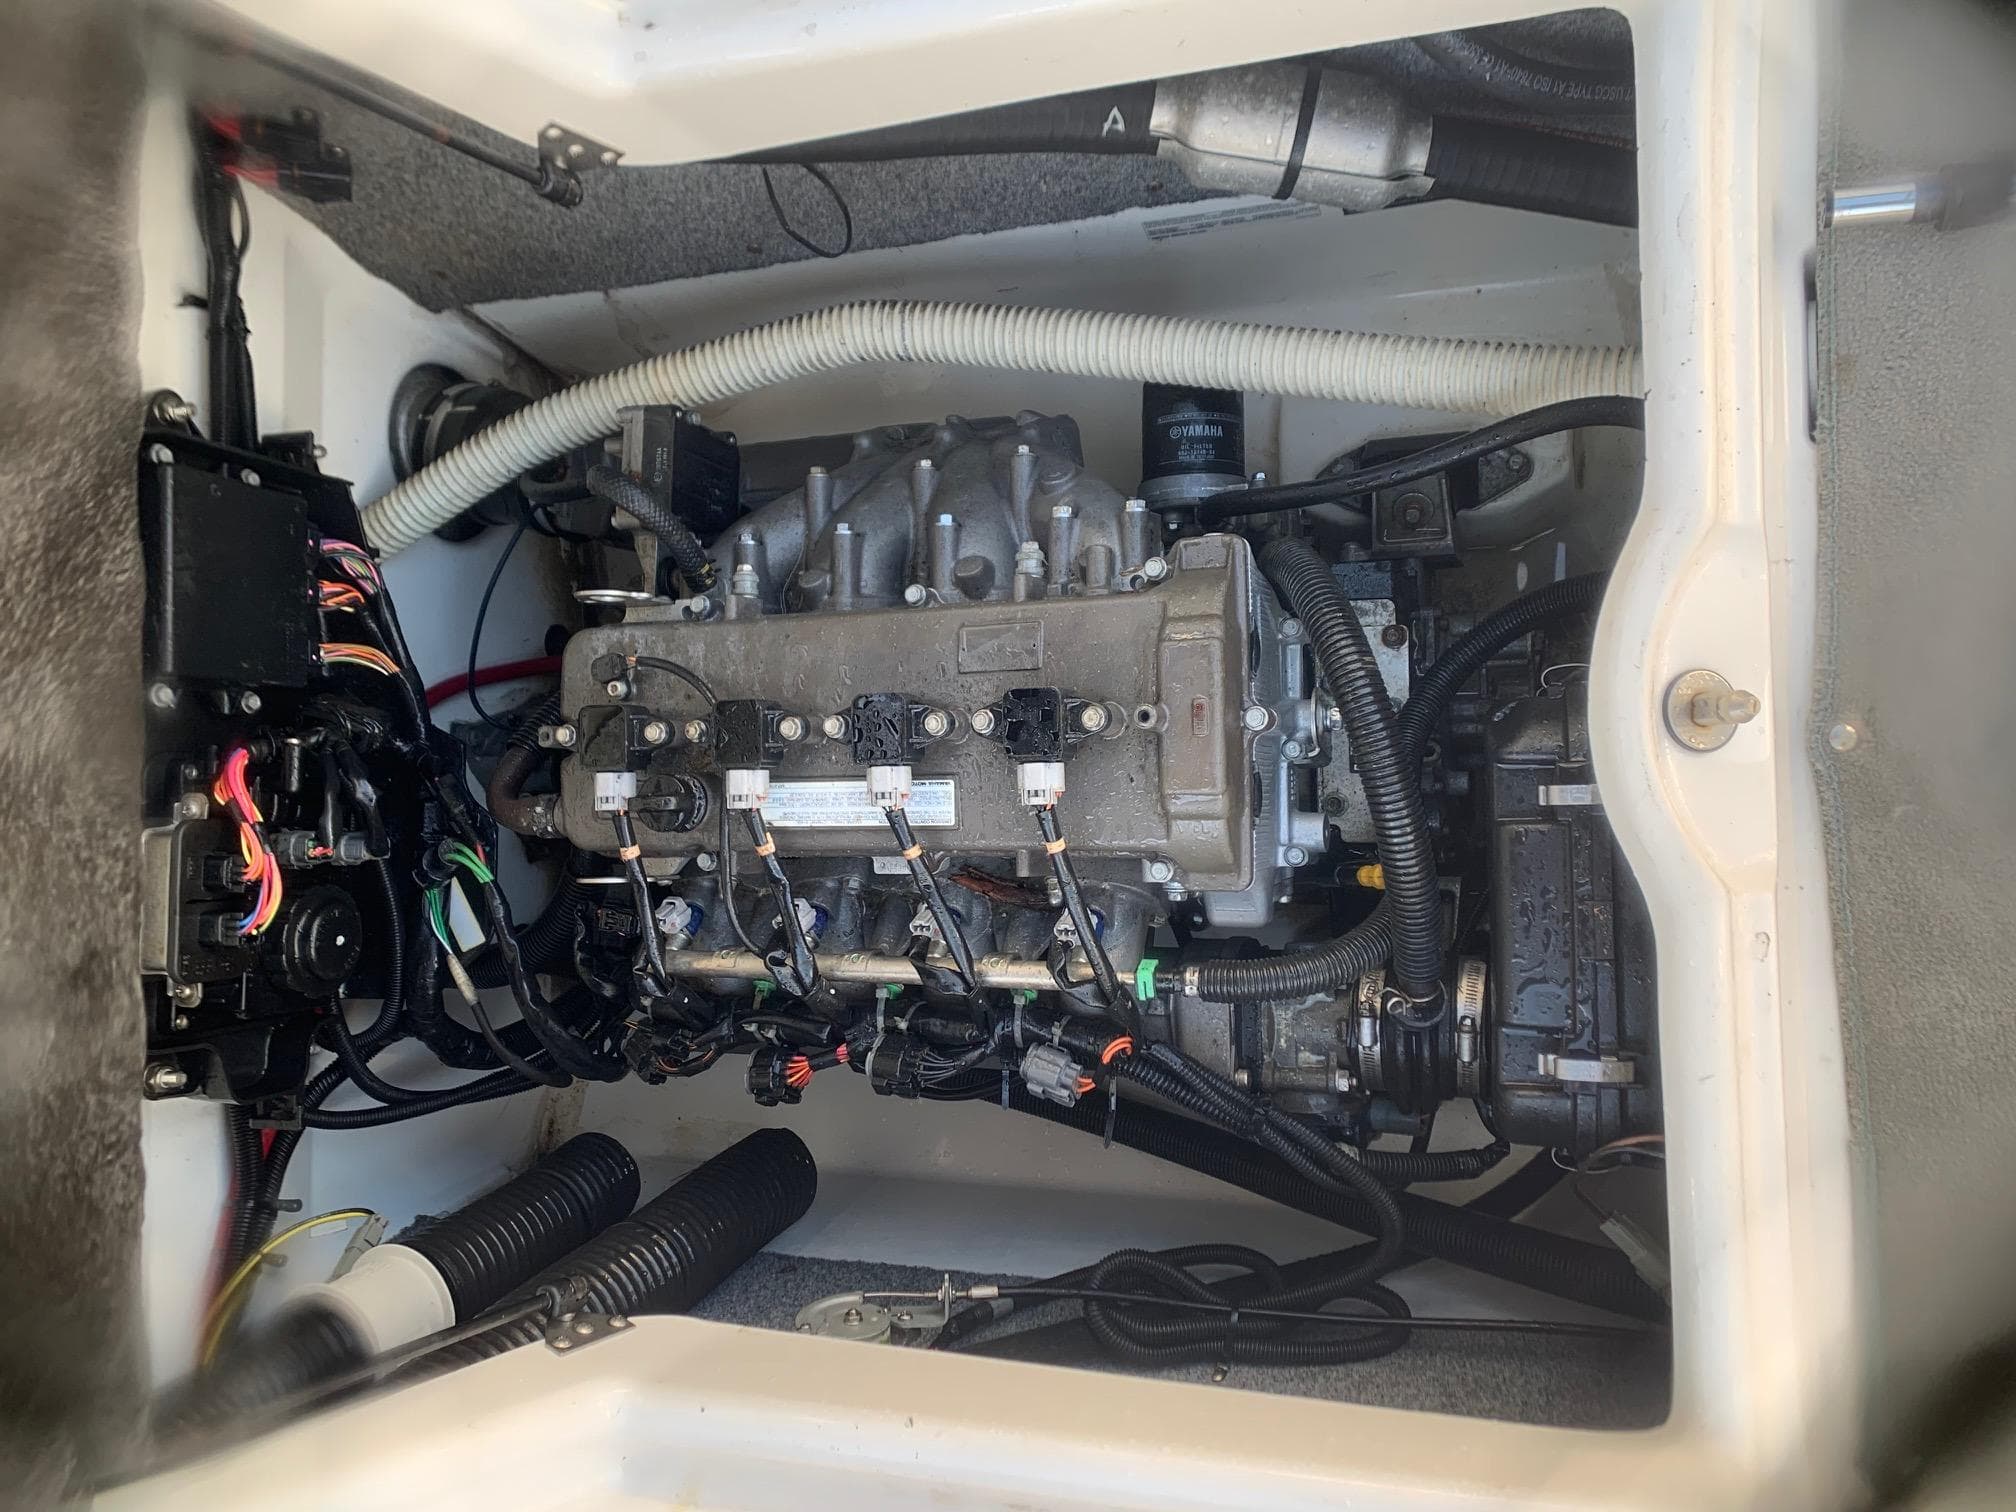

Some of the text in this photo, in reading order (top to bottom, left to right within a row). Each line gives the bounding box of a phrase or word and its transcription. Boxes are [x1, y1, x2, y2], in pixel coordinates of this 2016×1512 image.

[1533, 74, 1553, 93] ISO
[1567, 82, 1592, 100] TYPE
[1101, 105, 1126, 137] A
[1182, 425, 1223, 437] YAMAHA
